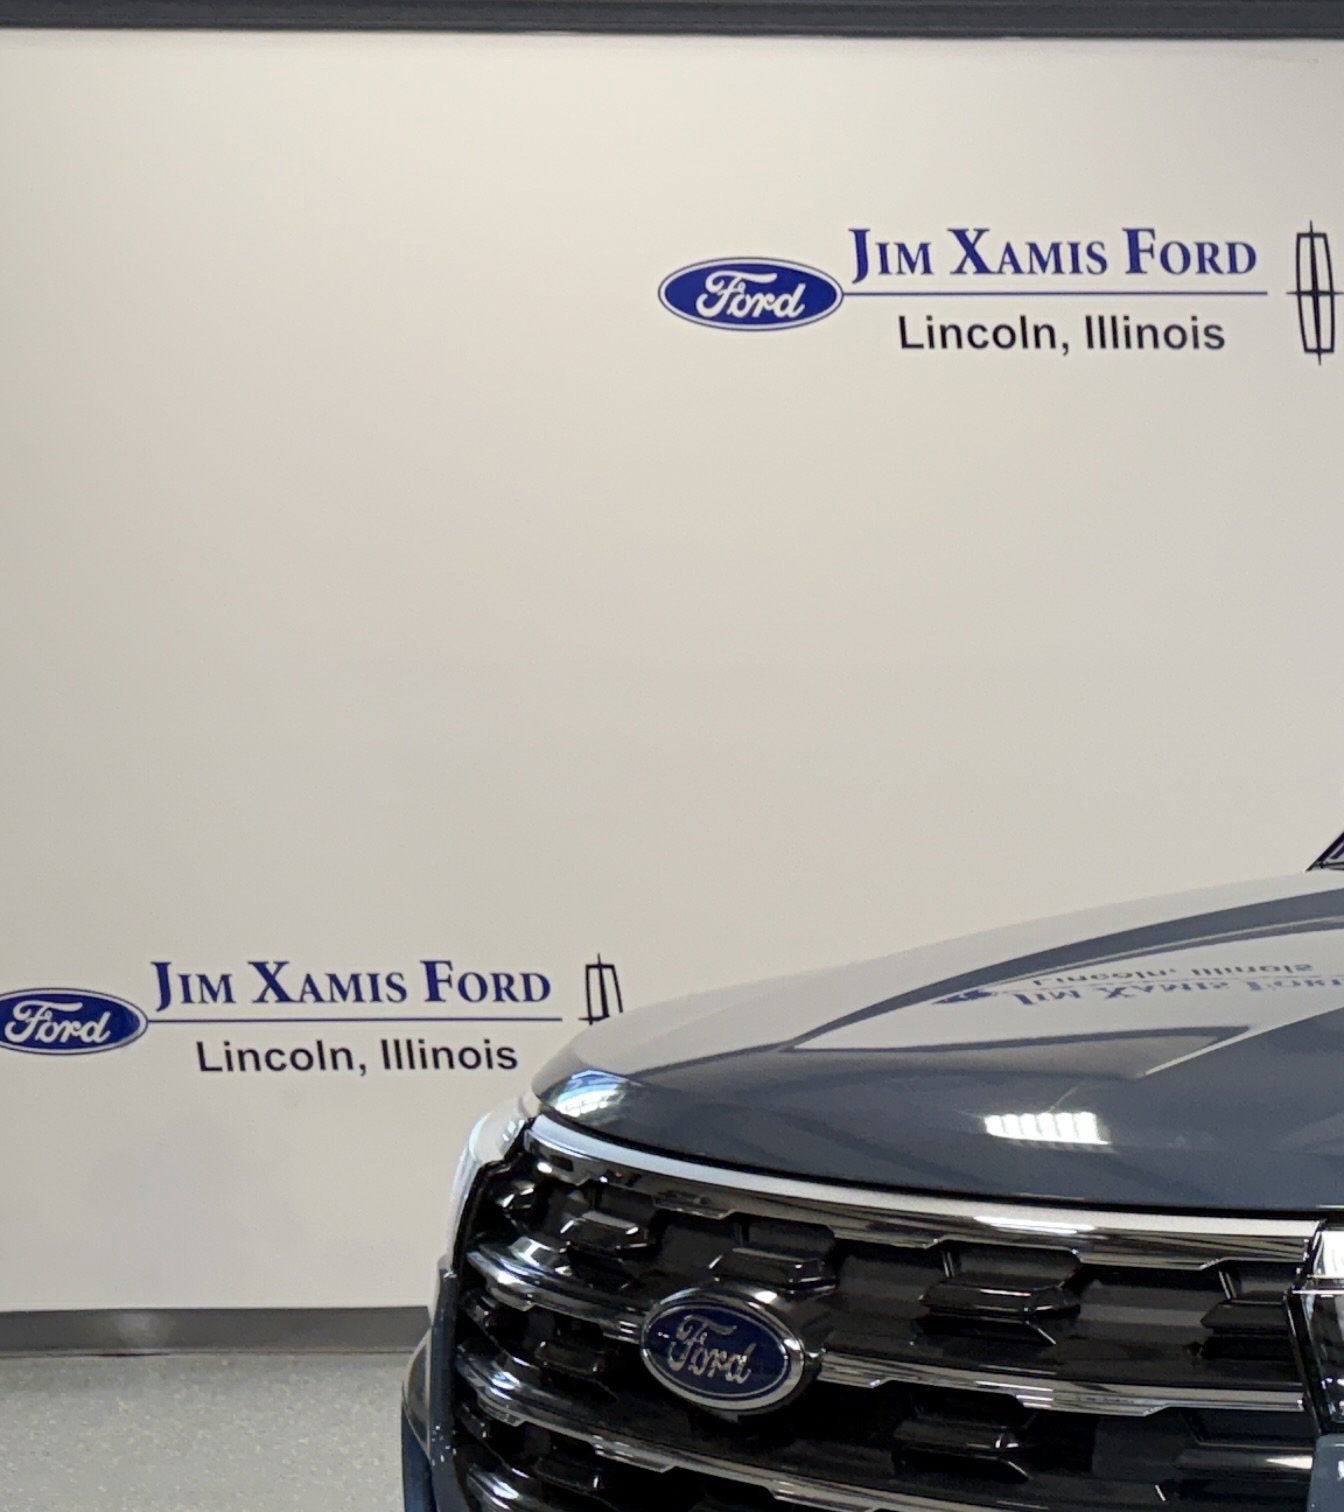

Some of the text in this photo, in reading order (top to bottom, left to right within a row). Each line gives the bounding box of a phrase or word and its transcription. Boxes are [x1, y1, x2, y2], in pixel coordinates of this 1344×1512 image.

[849, 228, 1257, 284] JIM XAMIS FORD
[695, 270, 806, 321] Ford
[898, 315, 1226, 356] Lincoln, Illinois
[151, 960, 551, 1012] JIM XAMIS FORD
[3, 1000, 112, 1045] Ford
[196, 1037, 519, 1077] Lincoln, Illinois
[667, 1313, 757, 1384] Ford
